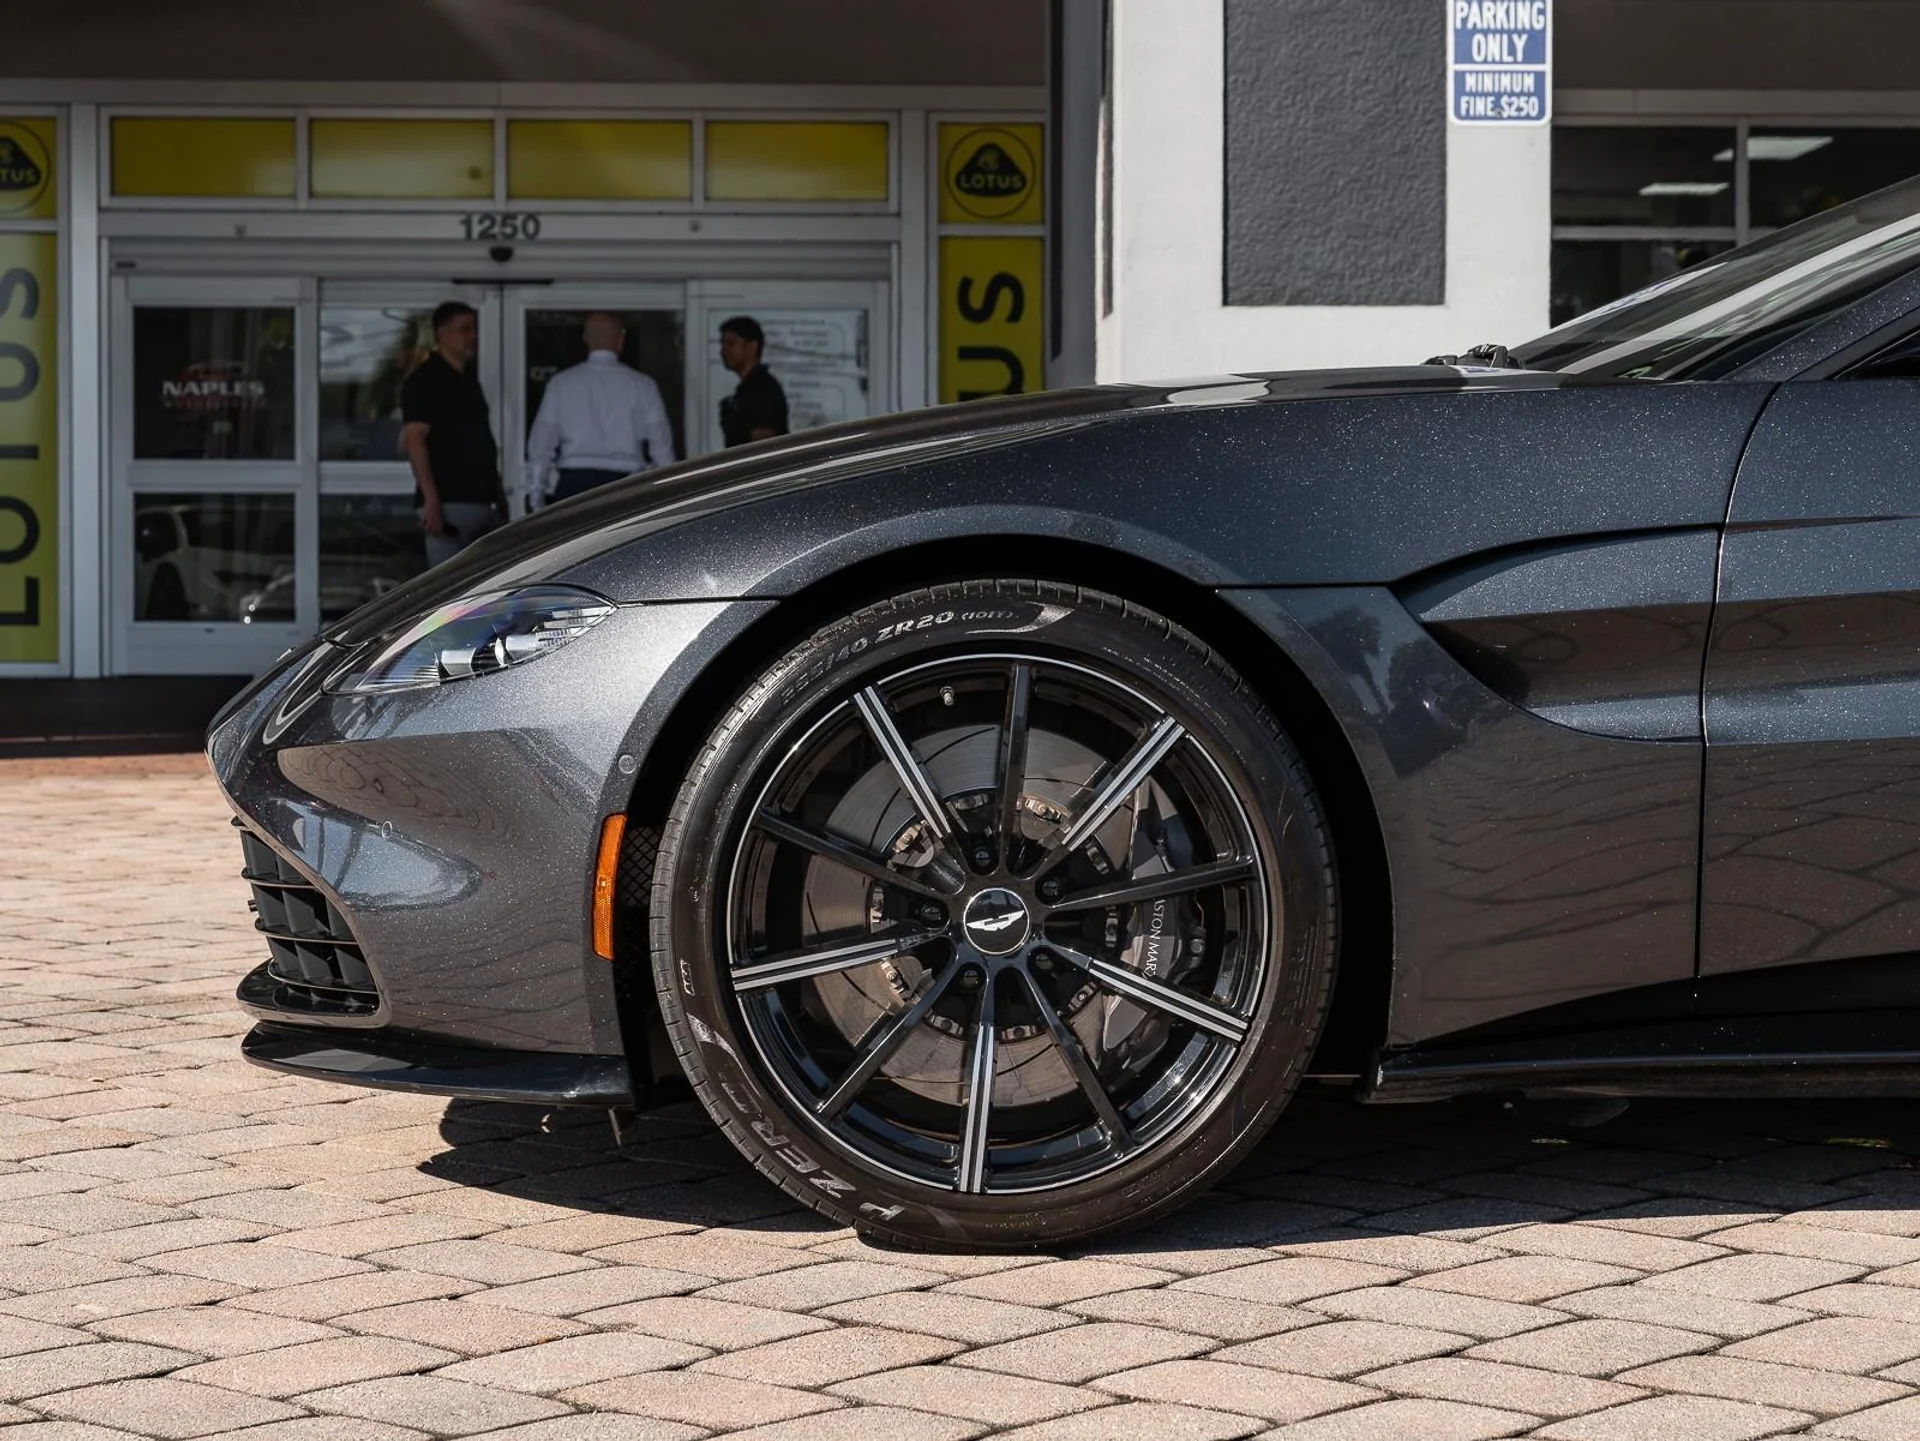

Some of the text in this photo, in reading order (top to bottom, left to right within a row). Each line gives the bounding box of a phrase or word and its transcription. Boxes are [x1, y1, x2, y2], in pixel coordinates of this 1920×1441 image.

[1455, 1, 1545, 30] PARKING
[1471, 33, 1528, 62] ONLY
[1465, 72, 1535, 93] MINIMUM
[1460, 95, 1539, 118] FINE $250
[960, 173, 1023, 189] LOTUS
[459, 213, 541, 240] 1250
[162, 380, 265, 397] NAPLES
[874, 610, 955, 644] ZR20
